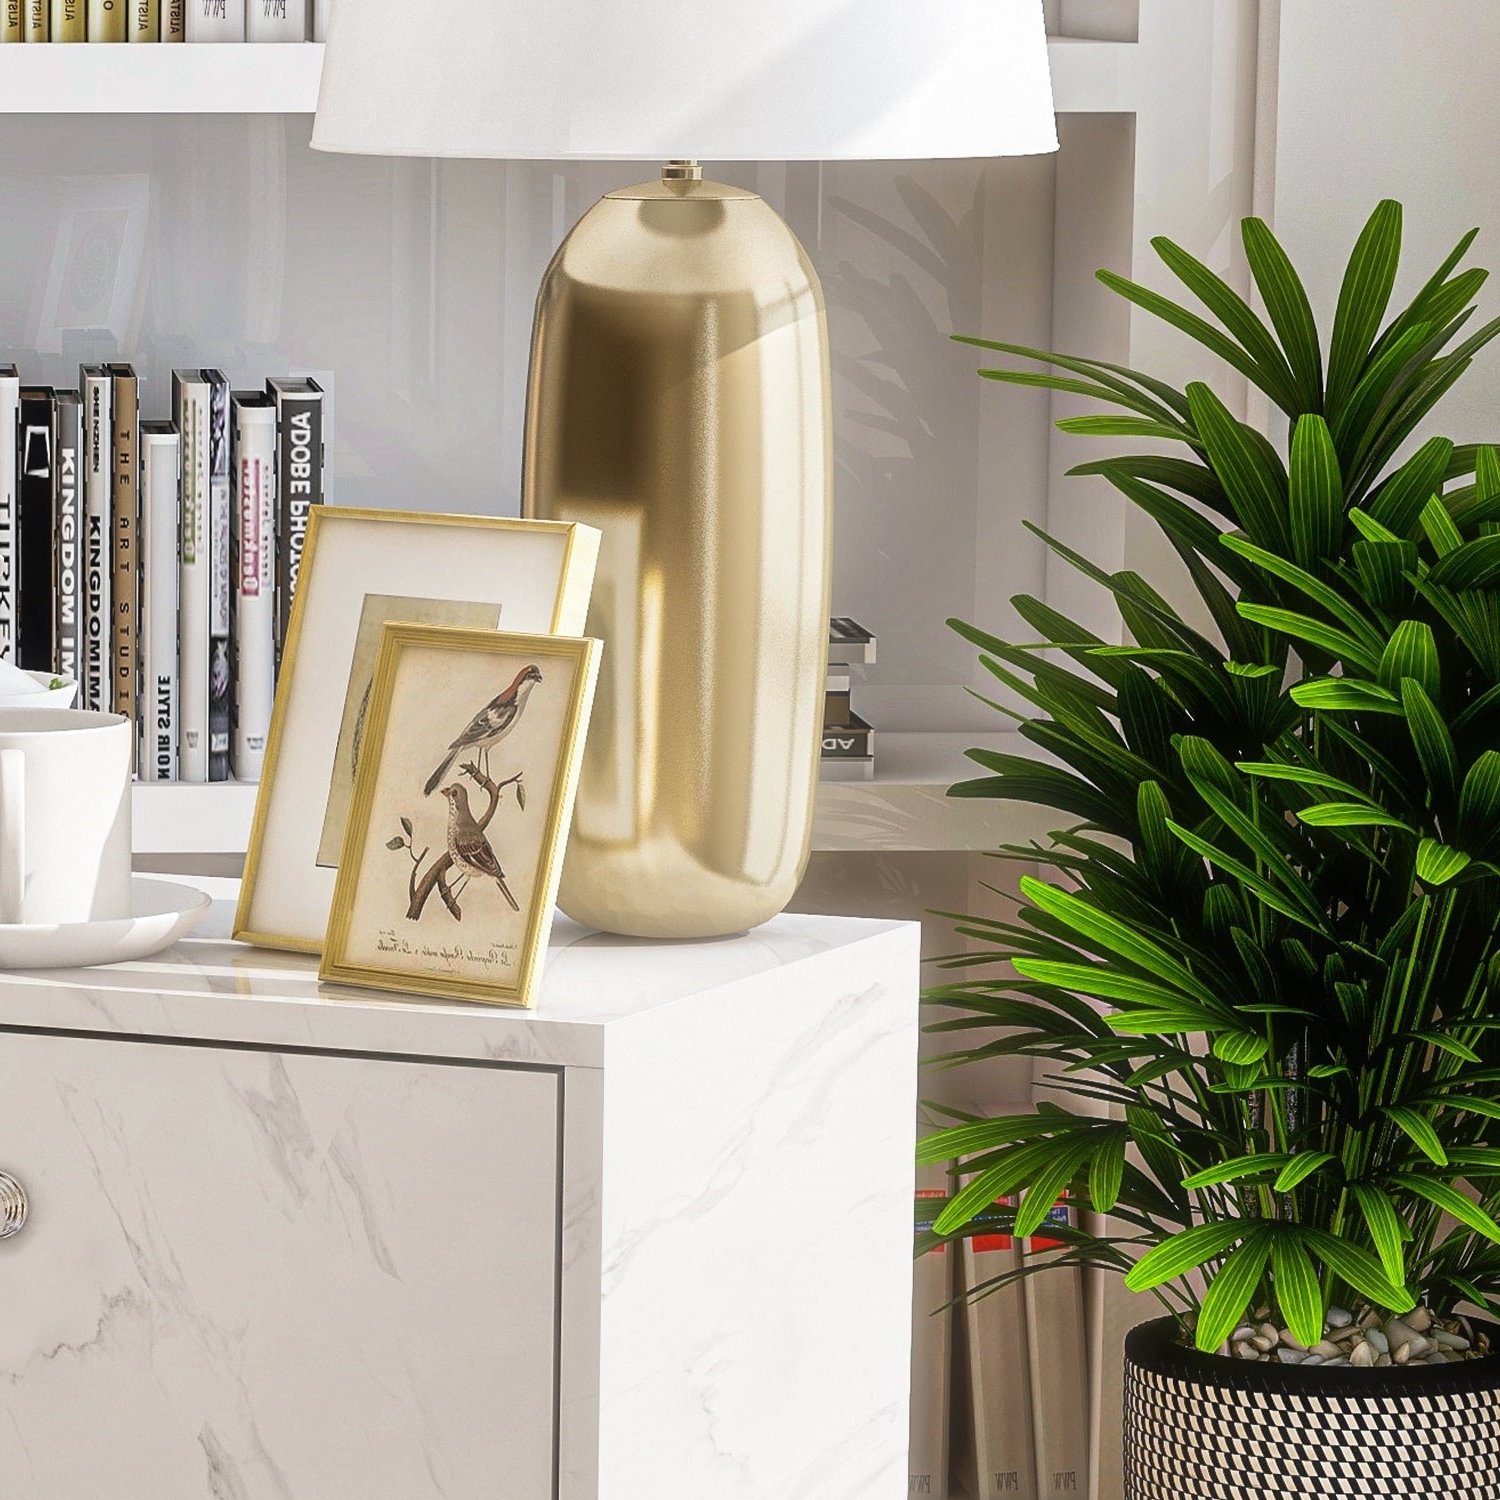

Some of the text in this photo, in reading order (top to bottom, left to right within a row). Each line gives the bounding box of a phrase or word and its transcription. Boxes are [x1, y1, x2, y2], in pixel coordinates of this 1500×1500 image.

[120, 430, 130, 485] THE
[61, 448, 75, 624] KINGDOM
[120, 517, 130, 572] ART
